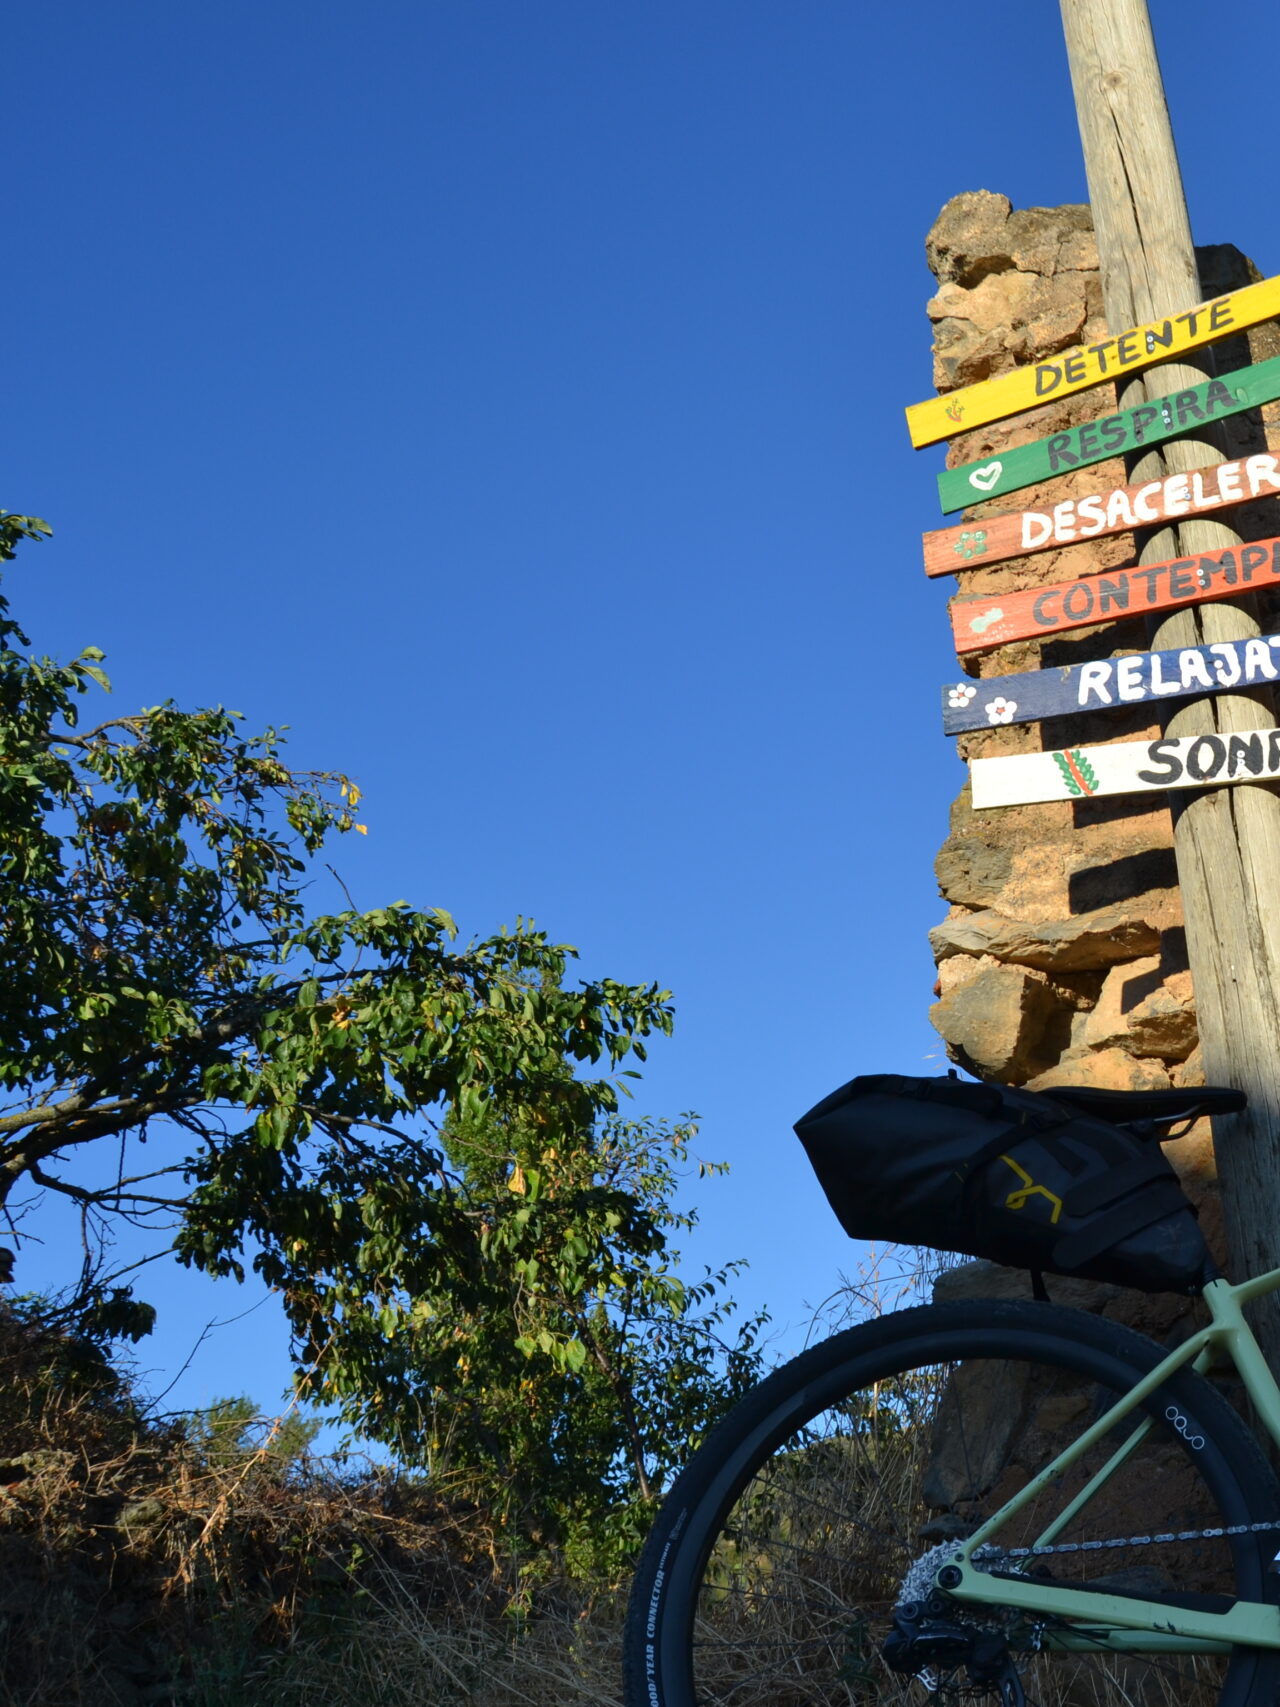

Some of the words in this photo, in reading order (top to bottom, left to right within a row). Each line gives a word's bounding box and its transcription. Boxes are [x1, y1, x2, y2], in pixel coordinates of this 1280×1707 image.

[1036, 298, 1235, 397] DETENTE
[1047, 379, 1238, 472] RESPIRA
[1165, 1406, 1205, 1450] OQUO
[647, 1570, 665, 1638] CONNECTOR
[646, 1644, 659, 1707] OODYEAR
